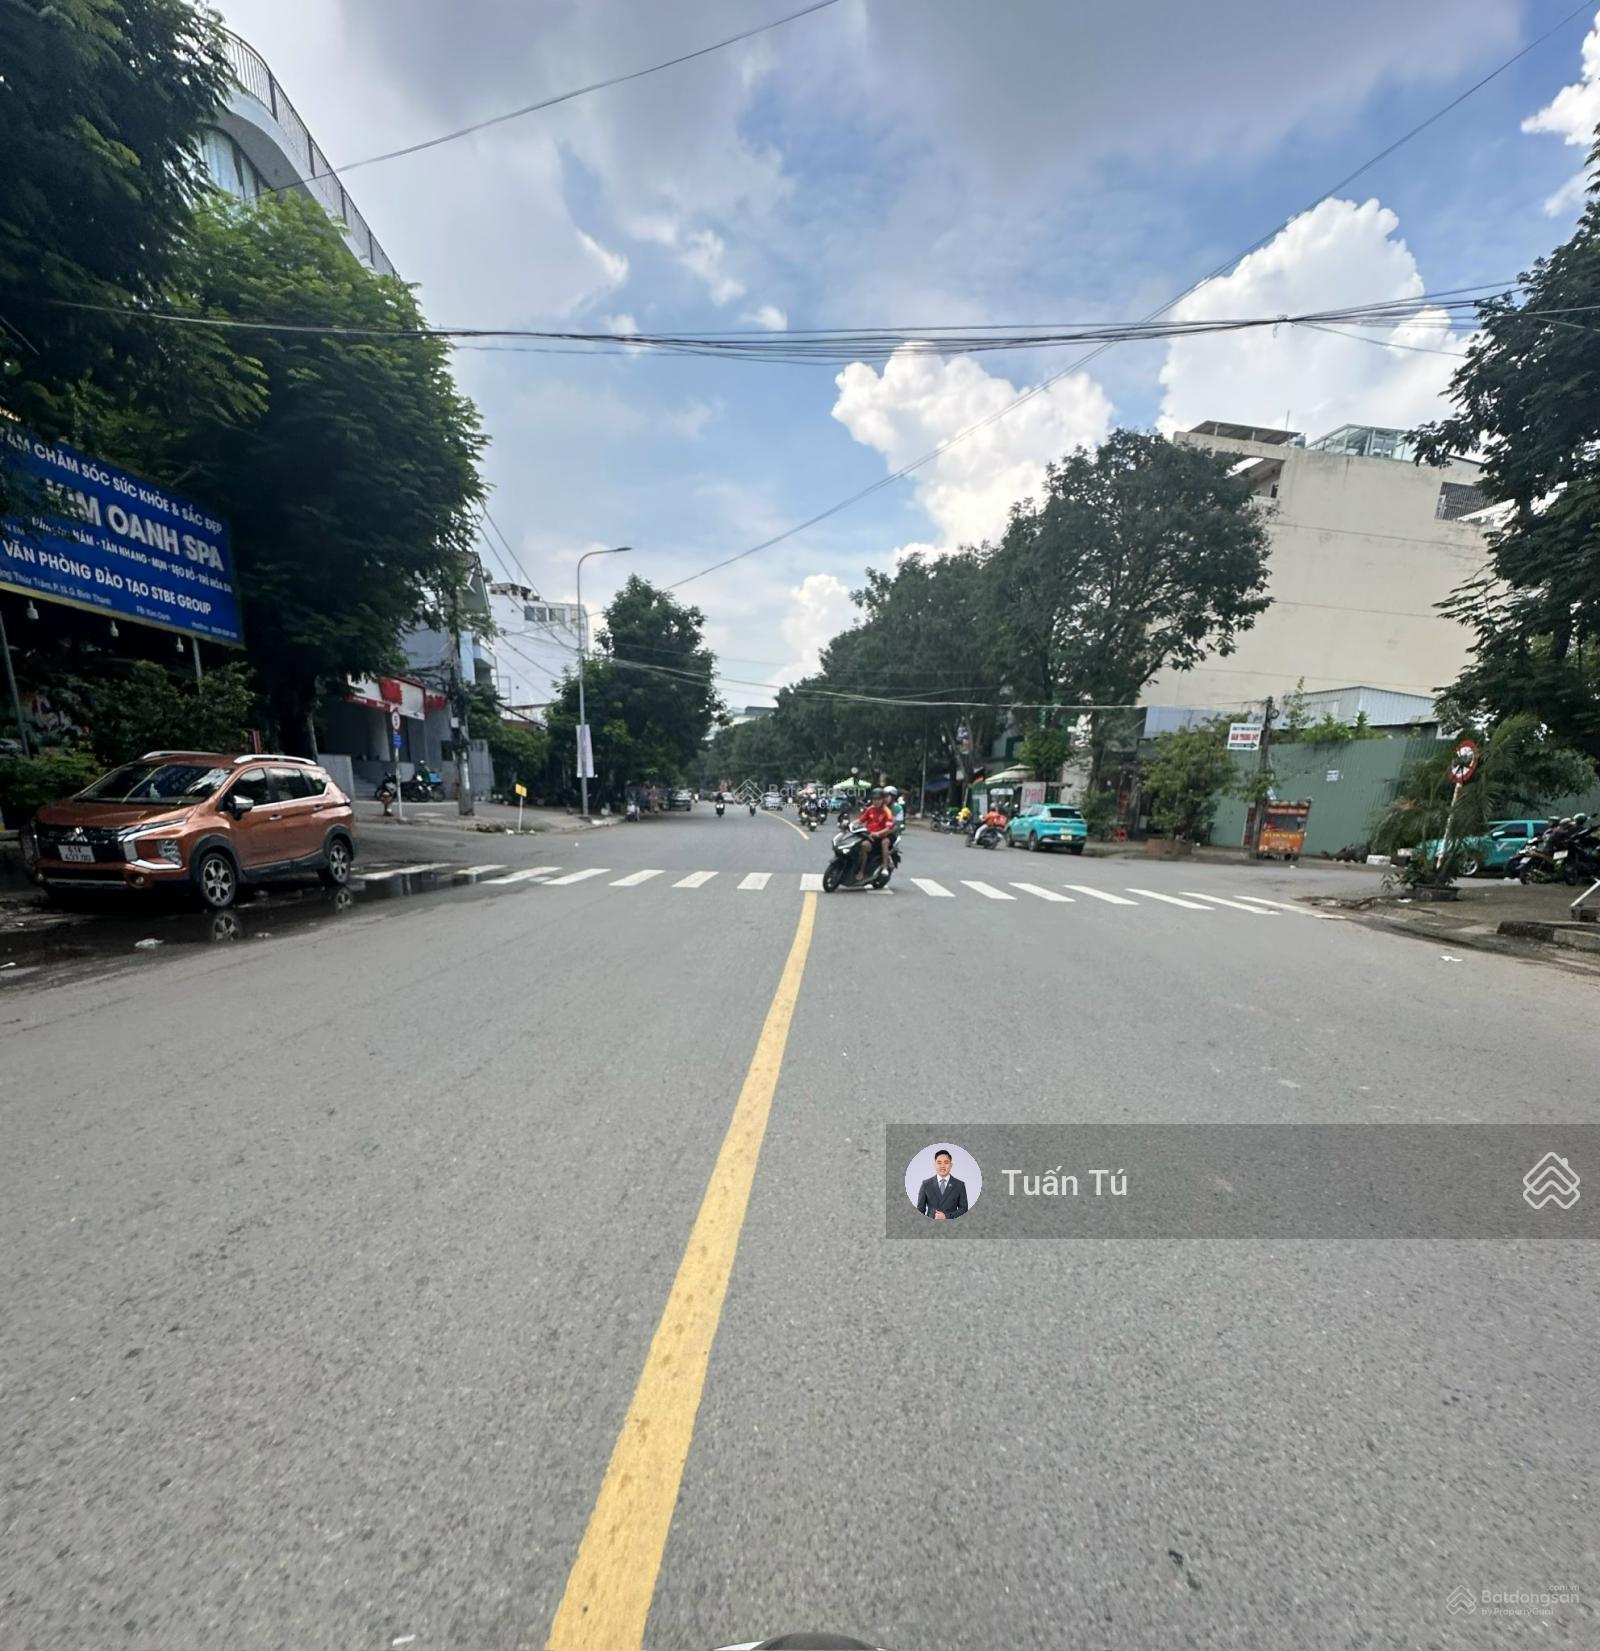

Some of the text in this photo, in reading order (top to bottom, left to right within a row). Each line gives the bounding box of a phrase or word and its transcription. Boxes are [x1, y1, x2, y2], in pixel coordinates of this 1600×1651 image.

[33, 443, 79, 474] CHĂM
[81, 463, 110, 486] SÓC
[112, 476, 138, 498] SỨC
[171, 502, 180, 517] &
[181, 504, 203, 526] SẮC
[106, 503, 180, 556] OANH
[182, 534, 225, 572] SPA
[2, 539, 212, 615] VĂN PHÒNG ĐÀO TẠO STBE GROUP
